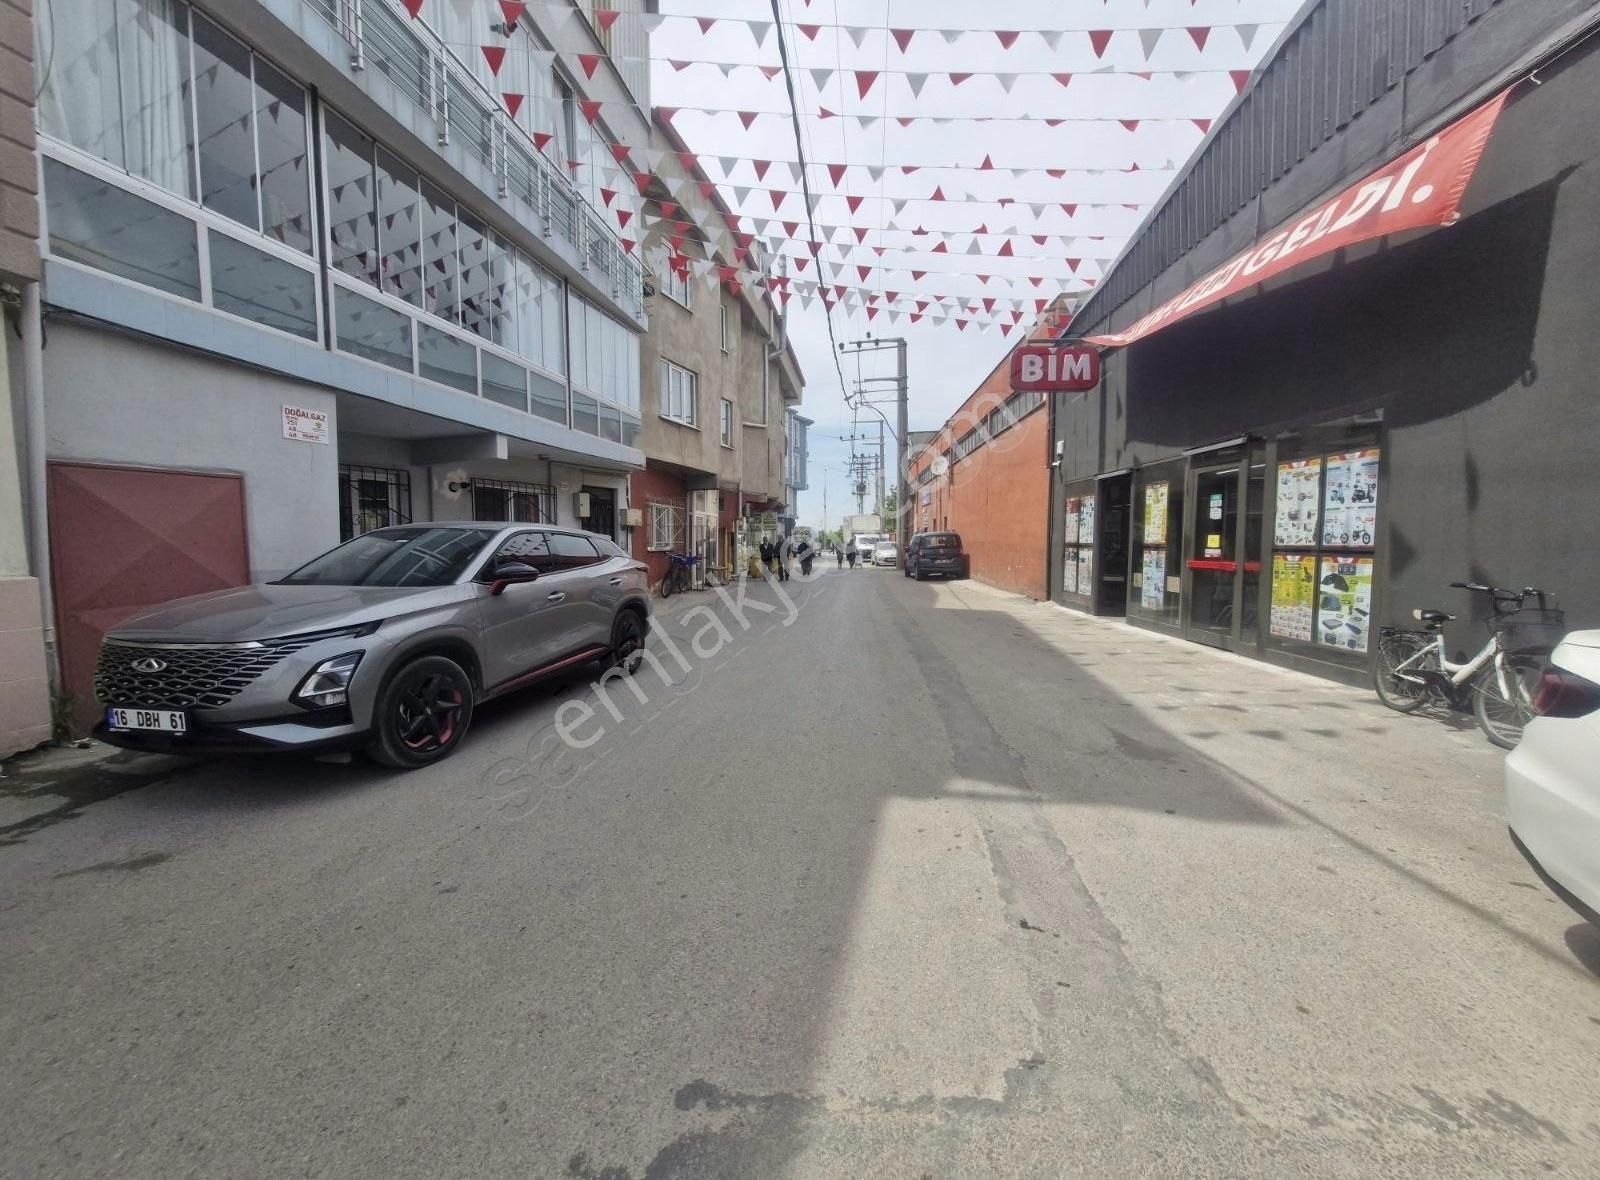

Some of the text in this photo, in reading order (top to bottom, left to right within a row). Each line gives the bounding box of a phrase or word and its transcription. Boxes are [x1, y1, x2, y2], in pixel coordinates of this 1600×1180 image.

[1243, 136, 1440, 276] GELDİ.
[1021, 347, 1092, 382] BİM
[114, 709, 185, 730] 16 DBH 61
